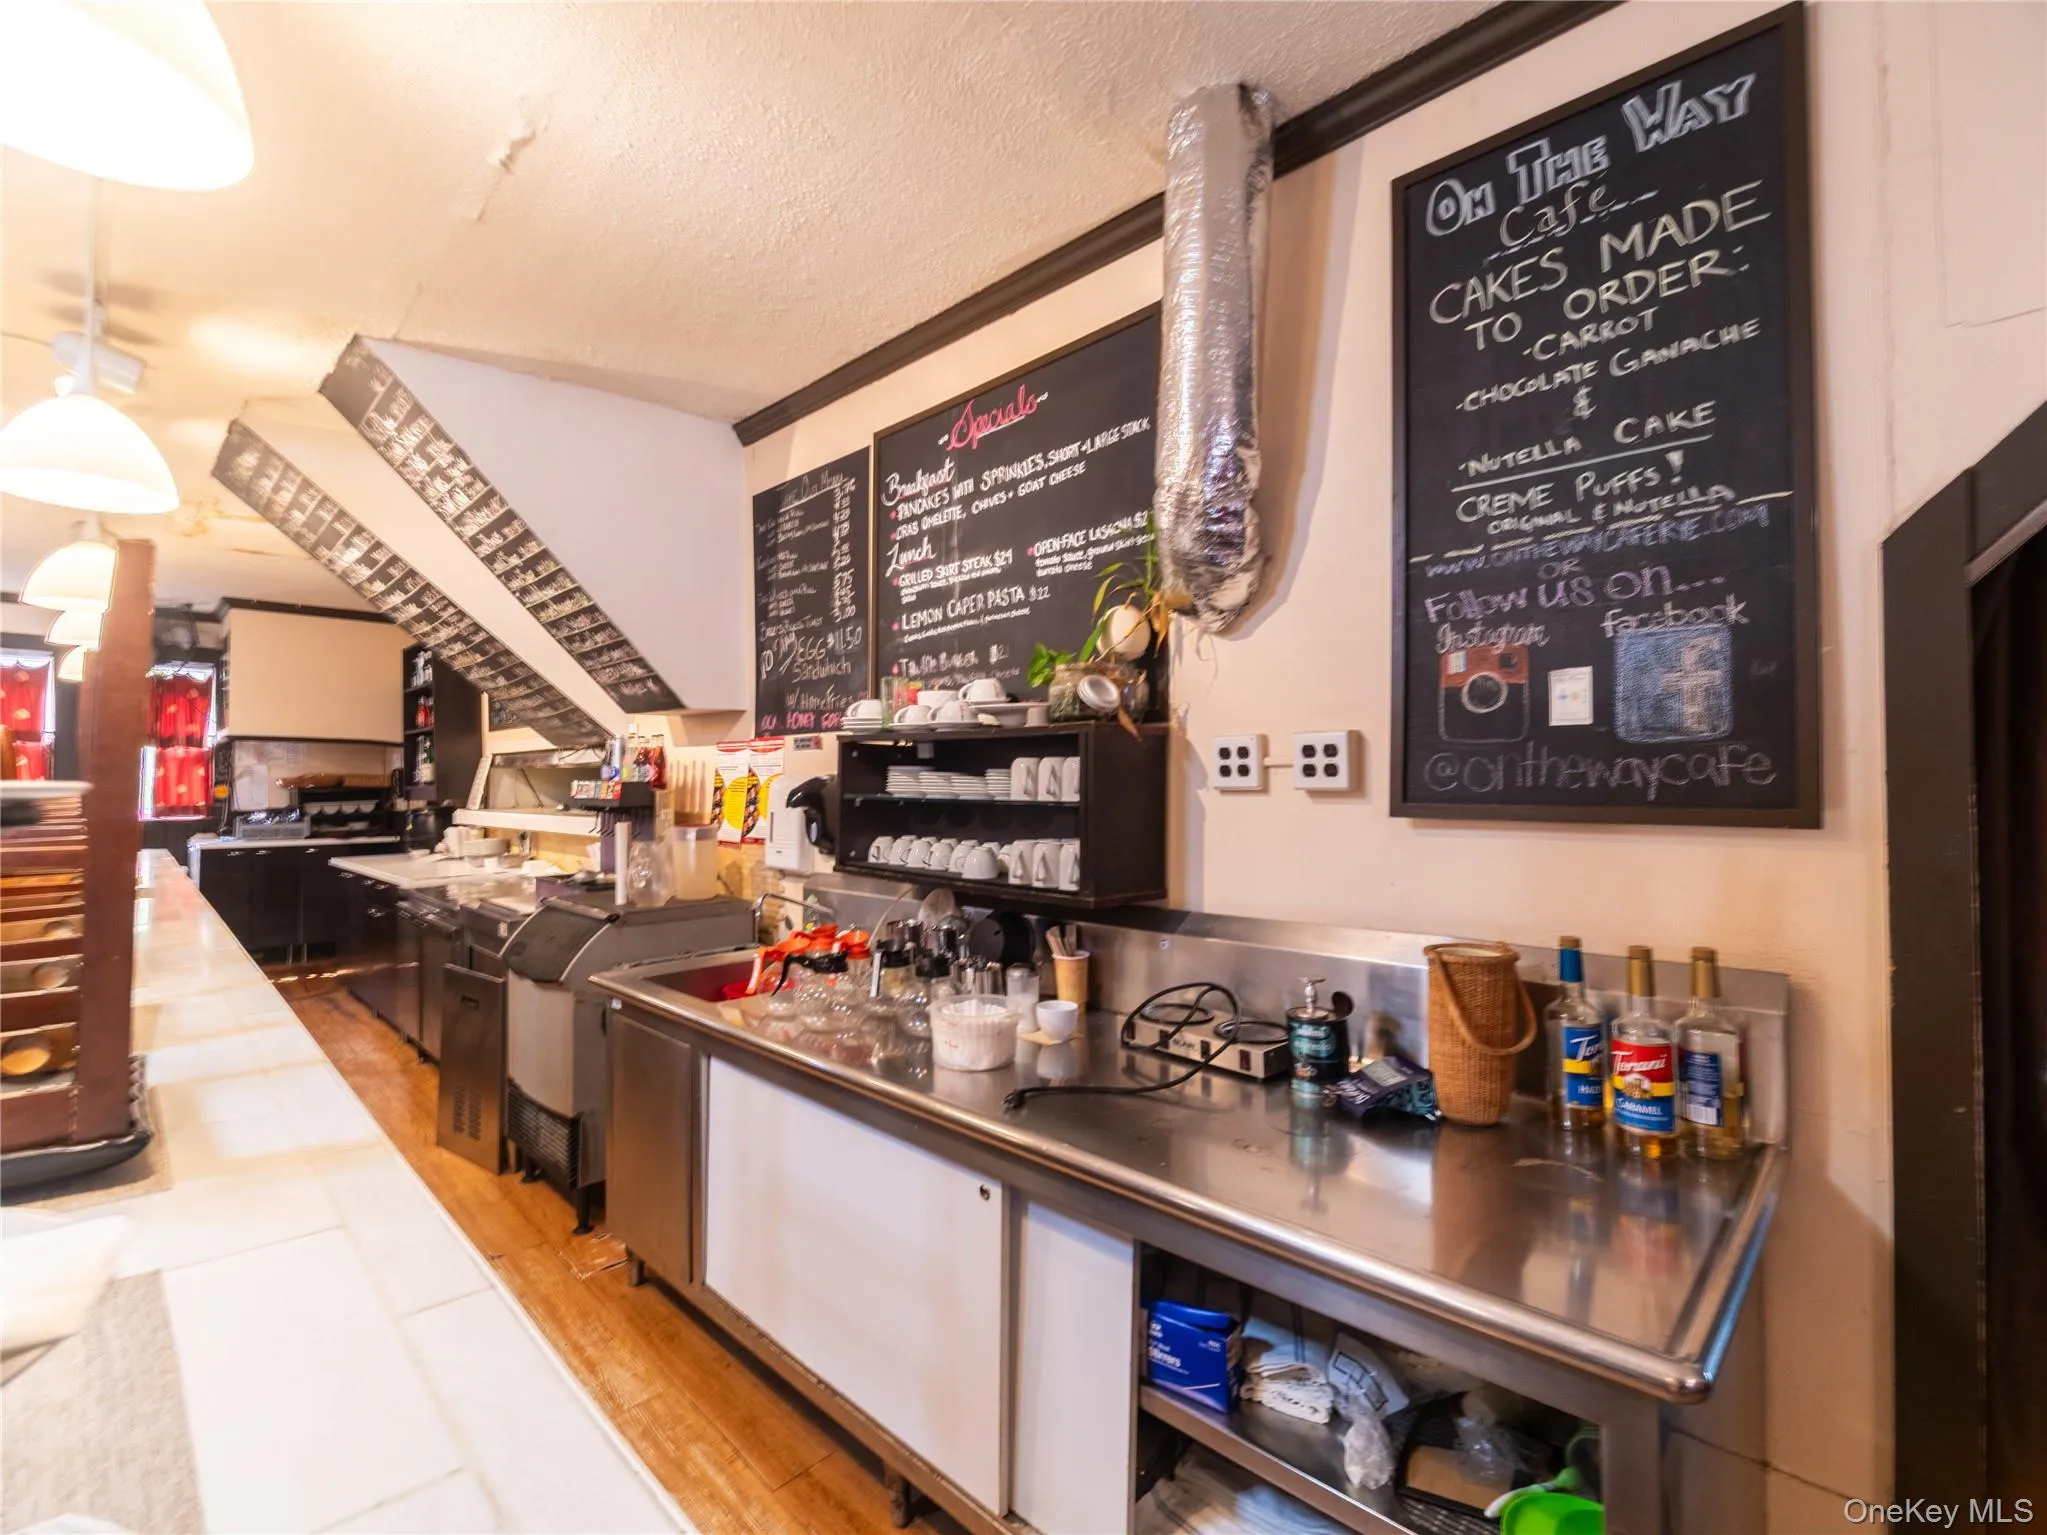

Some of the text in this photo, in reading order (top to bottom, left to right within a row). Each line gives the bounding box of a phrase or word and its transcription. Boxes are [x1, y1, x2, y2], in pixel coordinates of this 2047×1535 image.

[1429, 180, 1771, 323] CAKES MADE
[1465, 312, 1522, 350] TO
[1609, 318, 1761, 377] GANACHE
[1614, 401, 1717, 444] CAKE
[881, 457, 955, 507] Breakfast
[896, 488, 949, 521] PANCAKES
[953, 477, 974, 498] WITH
[1047, 441, 1081, 466] SHORT
[1086, 426, 1120, 454] LARGE
[1121, 416, 1152, 440] STACK
[896, 520, 918, 541] CRAB
[971, 492, 1006, 514] CHIVES
[1018, 475, 1047, 497] GOAT
[1050, 460, 1086, 484] CHEESE
[1456, 483, 1554, 523] CREME
[1613, 484, 1736, 516] NUTELLA
[885, 535, 937, 577] Lunch
[900, 568, 933, 587] GRILLED
[962, 555, 993, 572] STEAK
[902, 606, 943, 630] LEMON
[947, 593, 985, 617] CAPER
[987, 585, 1025, 608] PASTA
[1611, 1050, 1667, 1075] Torani
